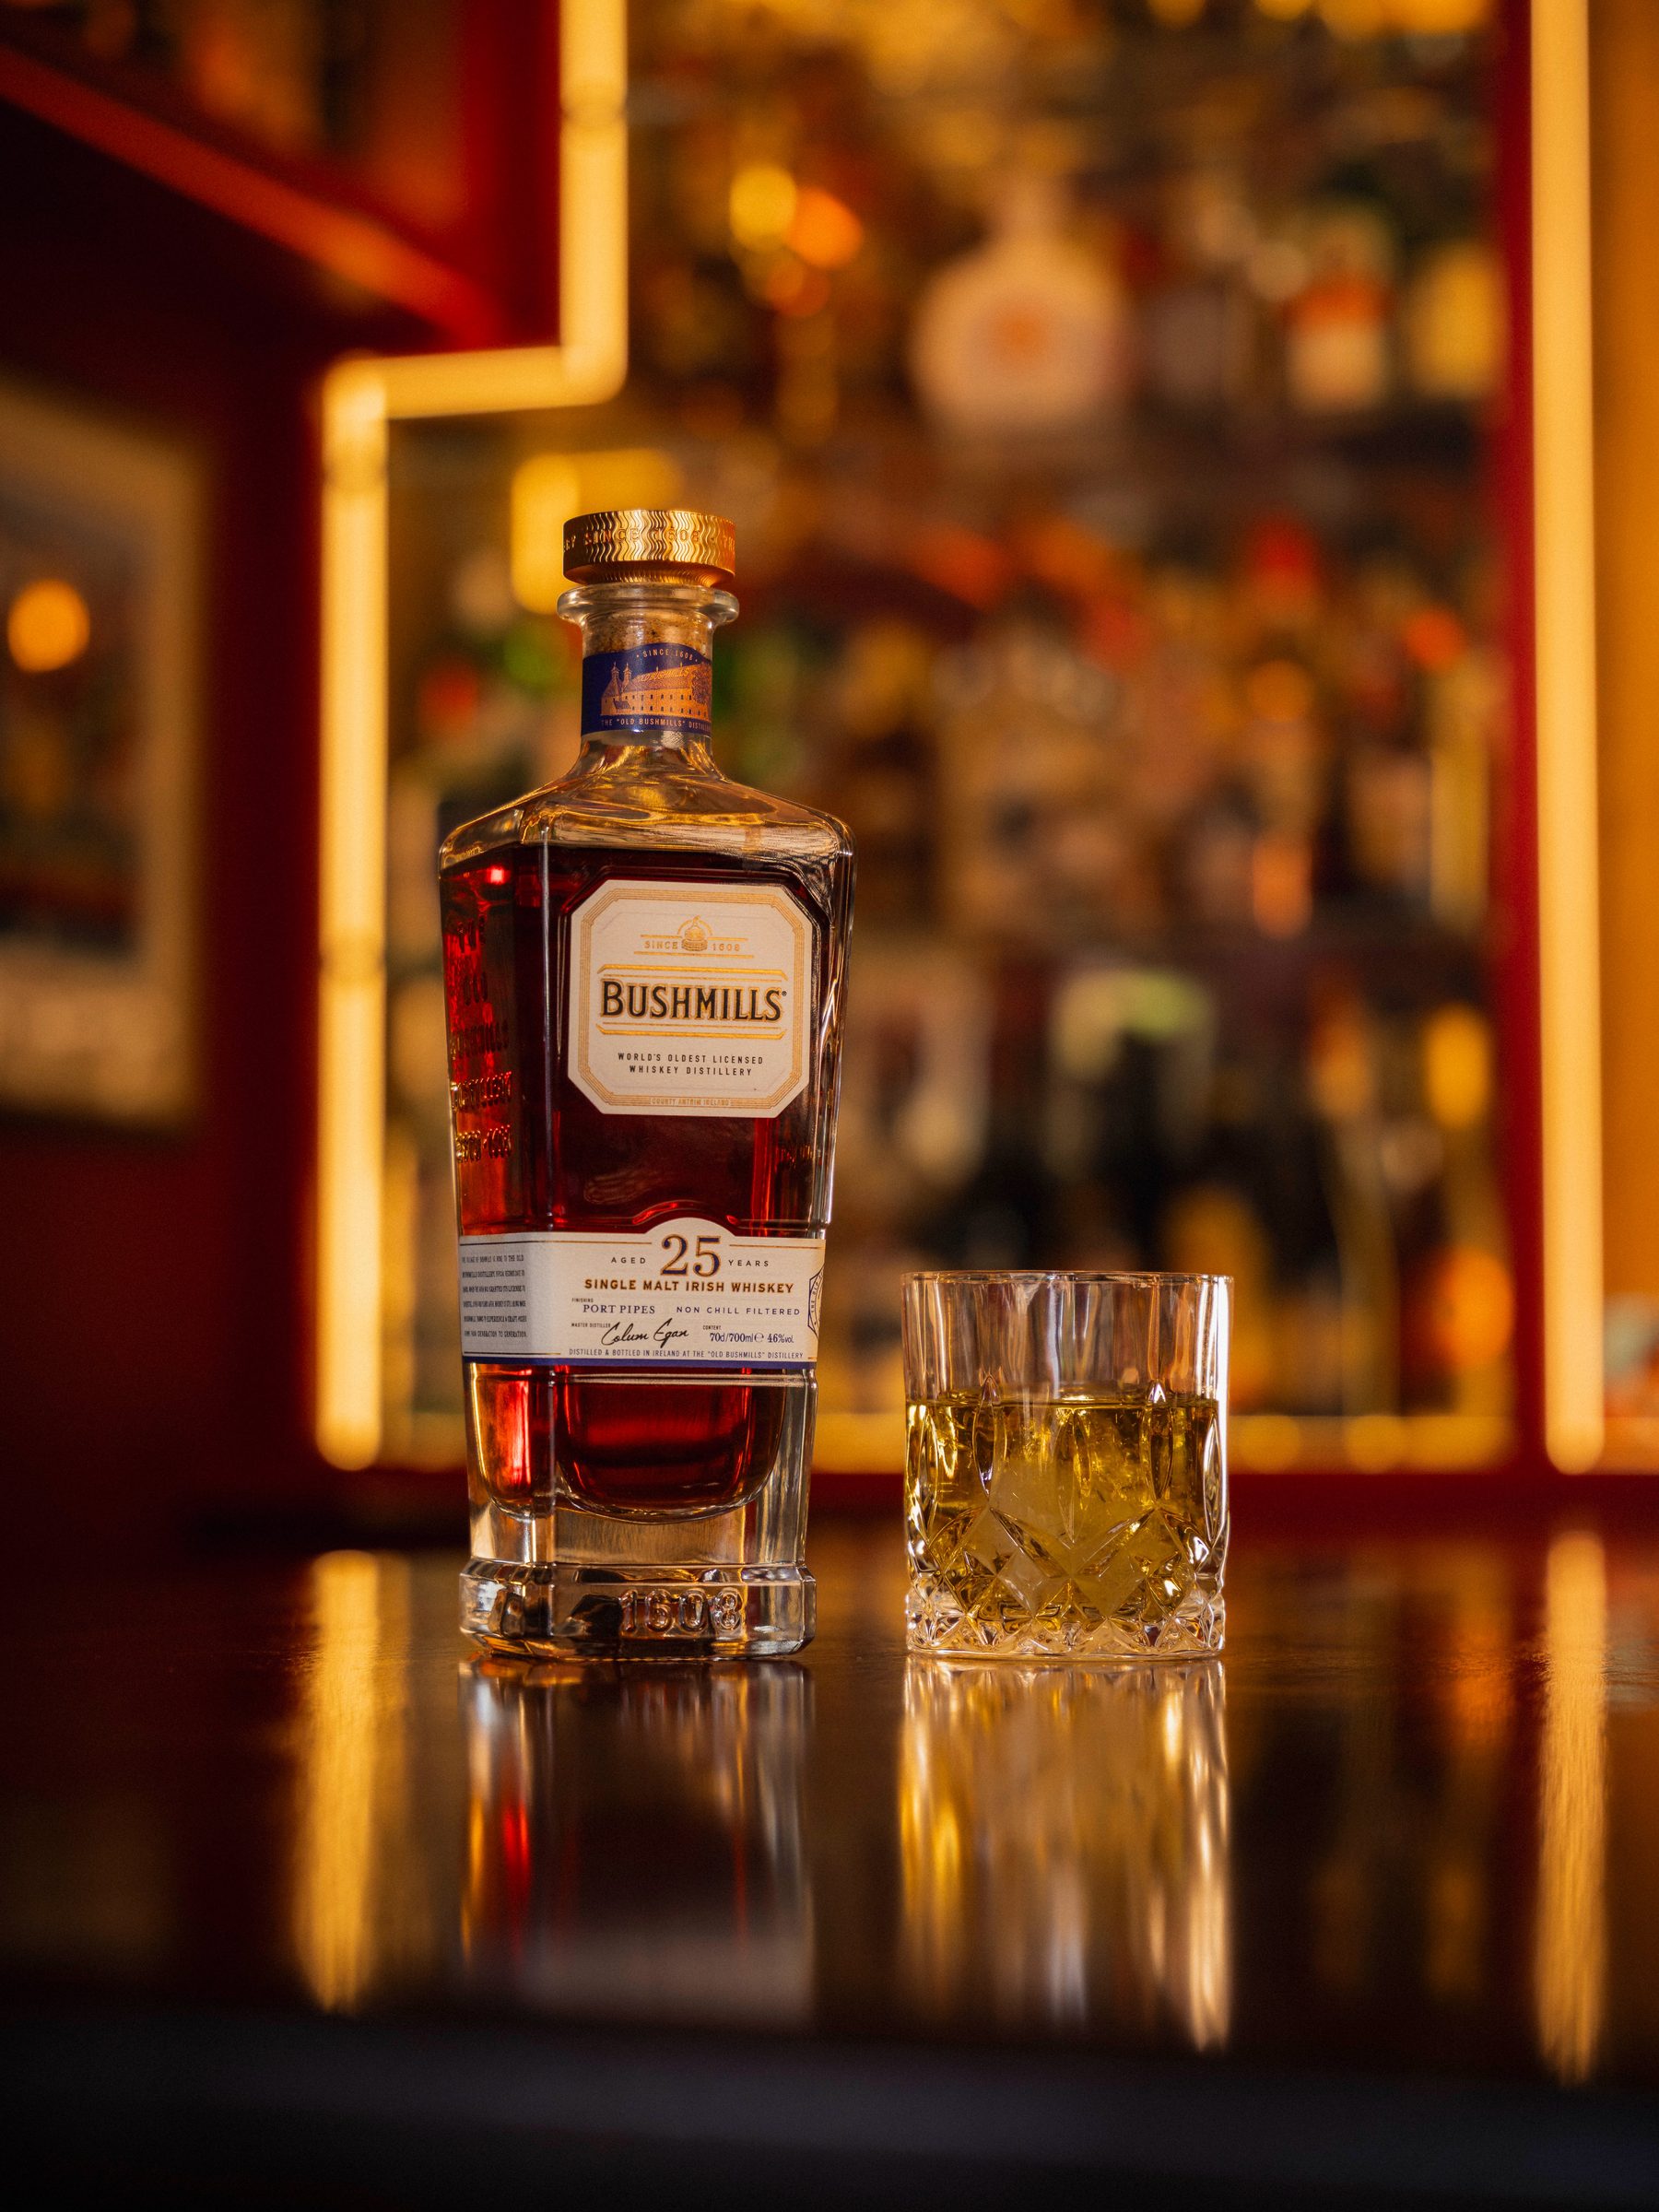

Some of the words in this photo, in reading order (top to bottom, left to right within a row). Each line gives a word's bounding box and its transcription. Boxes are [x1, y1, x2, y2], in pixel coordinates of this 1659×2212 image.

[584, 528, 641, 546] SINCE
[643, 649, 669, 658] SINCE
[676, 649, 693, 661] 1608
[639, 719, 686, 727] BUSHMILLS"
[644, 940, 678, 949] SINCE
[712, 943, 741, 952] 1608
[600, 978, 783, 1023] BUSHMILLS
[618, 1053, 662, 1061] WORLD'S
[667, 1054, 706, 1063] OLDEST
[712, 1055, 763, 1065] LICENSED
[629, 1065, 679, 1074] WHISKEY
[686, 1066, 752, 1076] DISTILLERY
[660, 1233, 721, 1277] 25
[584, 1278, 637, 1289] SINGLE
[642, 1280, 679, 1291] MALT
[685, 1281, 724, 1292] IRISH
[731, 1282, 794, 1293] WHISKEY
[582, 1304, 617, 1313] PORT
[619, 1305, 655, 1314] PIPES
[618, 1588, 743, 1632] 1608
